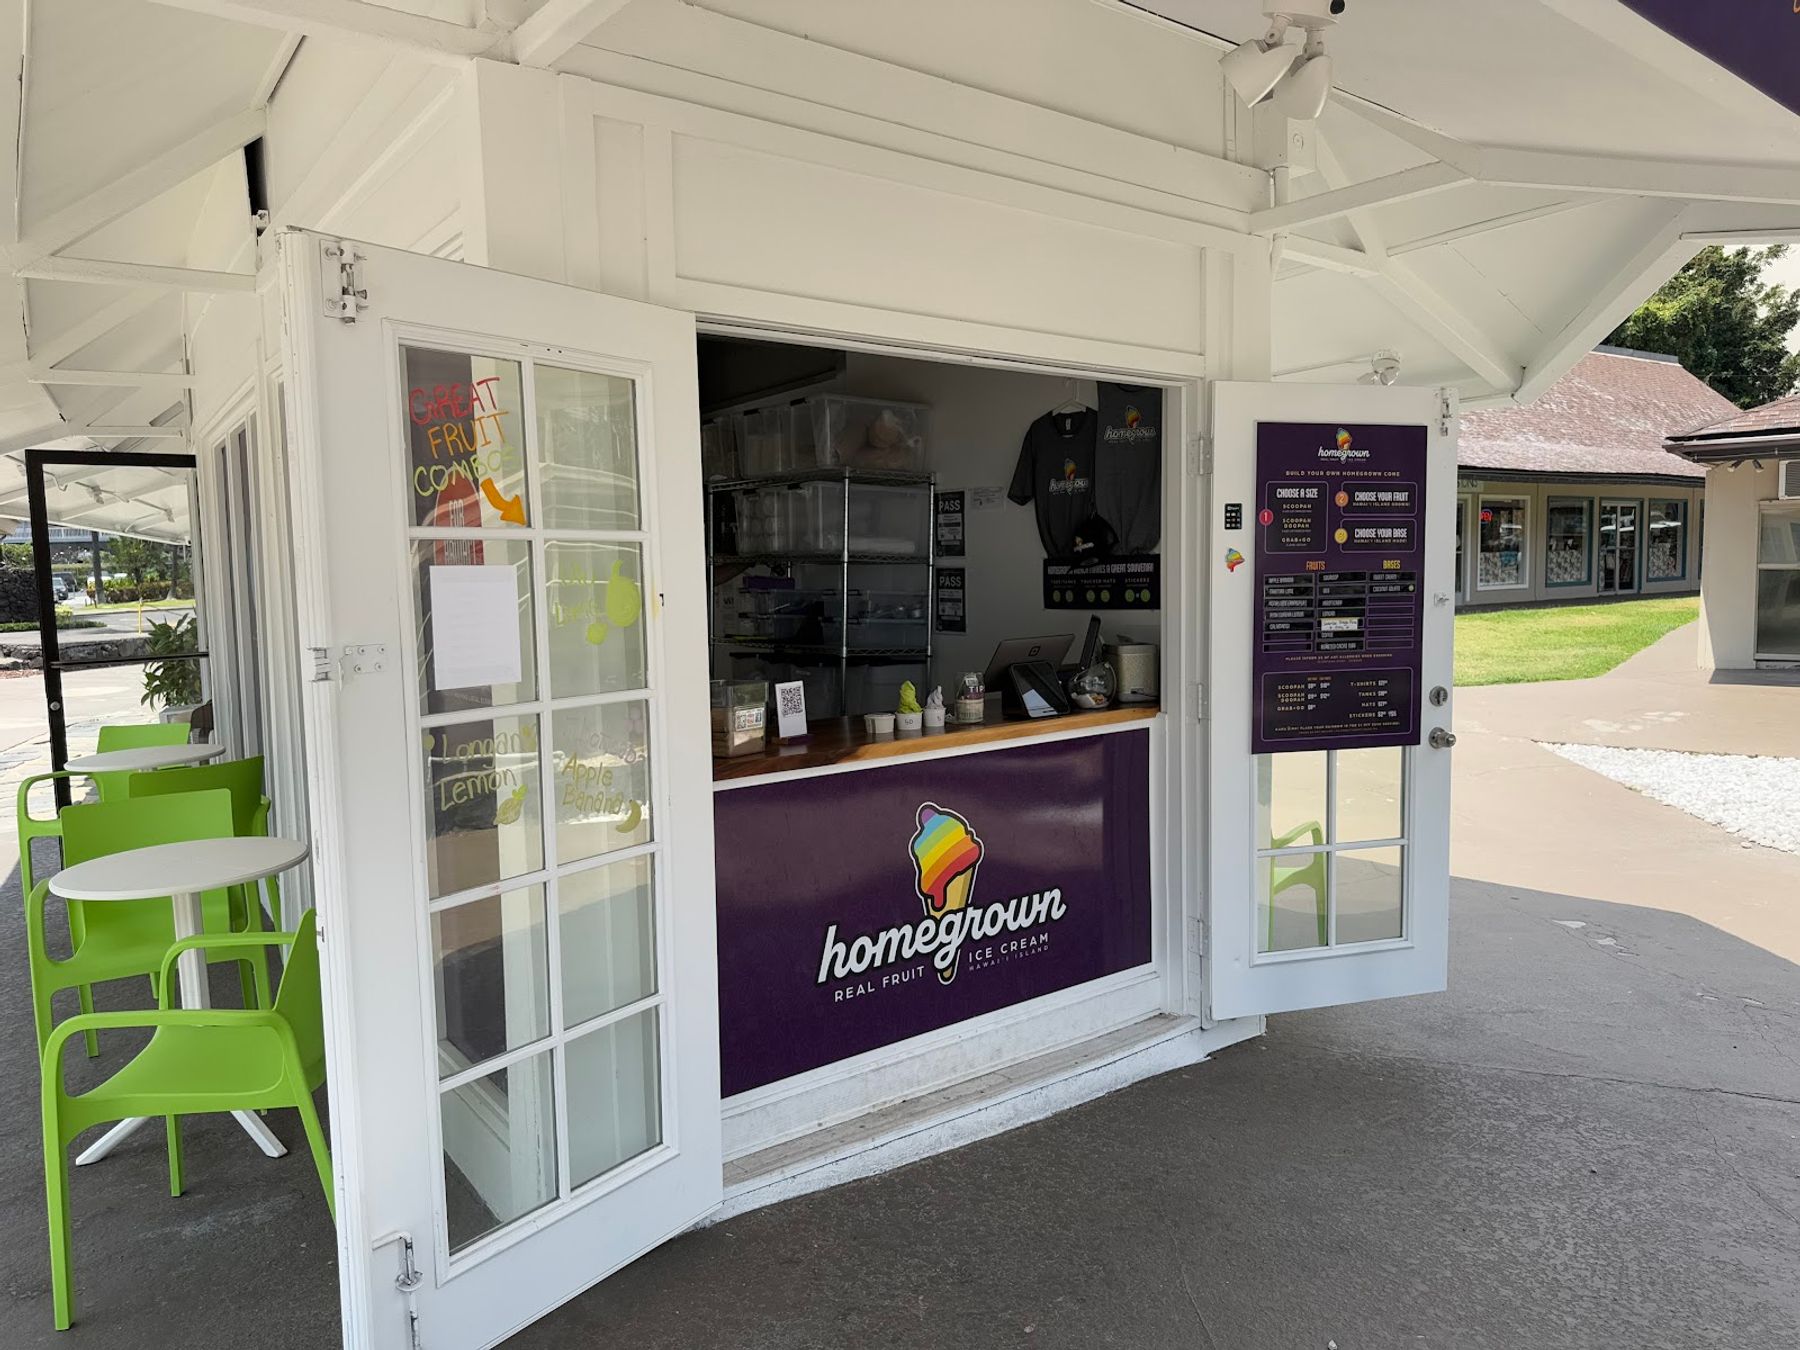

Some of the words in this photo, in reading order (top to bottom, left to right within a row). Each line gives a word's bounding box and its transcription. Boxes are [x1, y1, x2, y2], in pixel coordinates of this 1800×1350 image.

[409, 377, 500, 425] GREAT
[427, 410, 510, 460] FRUIT
[1318, 446, 1370, 461] homegrown
[413, 446, 521, 497] COMBOS
[939, 500, 961, 512] PASS
[1276, 488, 1299, 498] CHOOSE
[1300, 488, 1305, 498] A
[1305, 488, 1318, 498] SIZE
[1355, 492, 1377, 502] CHOOSE
[1378, 492, 1392, 502] YOUR
[1393, 492, 1409, 502] FRUIT
[1354, 528, 1377, 538] CHOOSE
[1377, 528, 1392, 538] YOUR
[1393, 528, 1407, 538] BASE
[1306, 561, 1326, 571] FRUITS
[1383, 560, 1401, 570] BASES
[939, 576, 961, 588] PASS
[441, 732, 521, 769] Longan
[561, 752, 614, 789] Apple
[439, 767, 518, 812] Lemon
[563, 784, 624, 815] Banana
[817, 888, 1067, 984] homegrown
[969, 948, 993, 964] ICE
[1001, 932, 1049, 955] CREAM
[1015, 945, 1050, 961] ISLAND
[834, 983, 875, 1003] REAL
[882, 966, 925, 989] FRUIT
